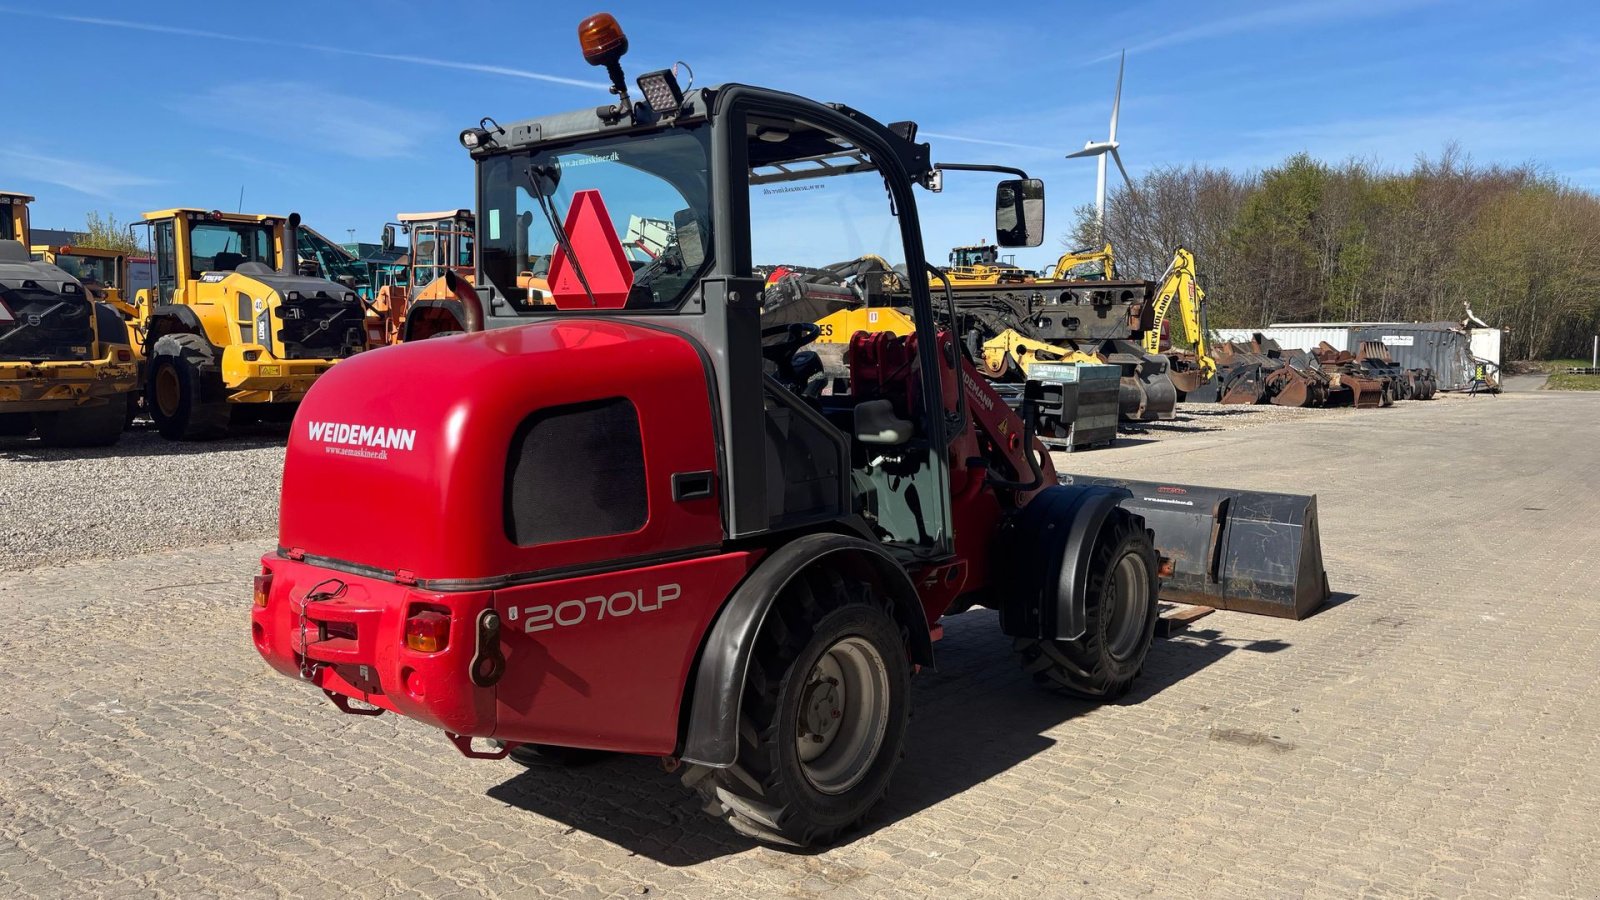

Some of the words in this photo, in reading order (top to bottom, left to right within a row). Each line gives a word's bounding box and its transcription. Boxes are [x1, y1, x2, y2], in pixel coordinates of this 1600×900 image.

[254, 301, 263, 310] 40
[1154, 294, 1171, 329] HOLLAND
[1150, 331, 1159, 350] NEW
[961, 369, 994, 412] IDEMANN
[308, 421, 416, 451] WEIDEMANN
[325, 446, 388, 460] www.aemaskiner.dk
[524, 583, 681, 633] 2070LP
